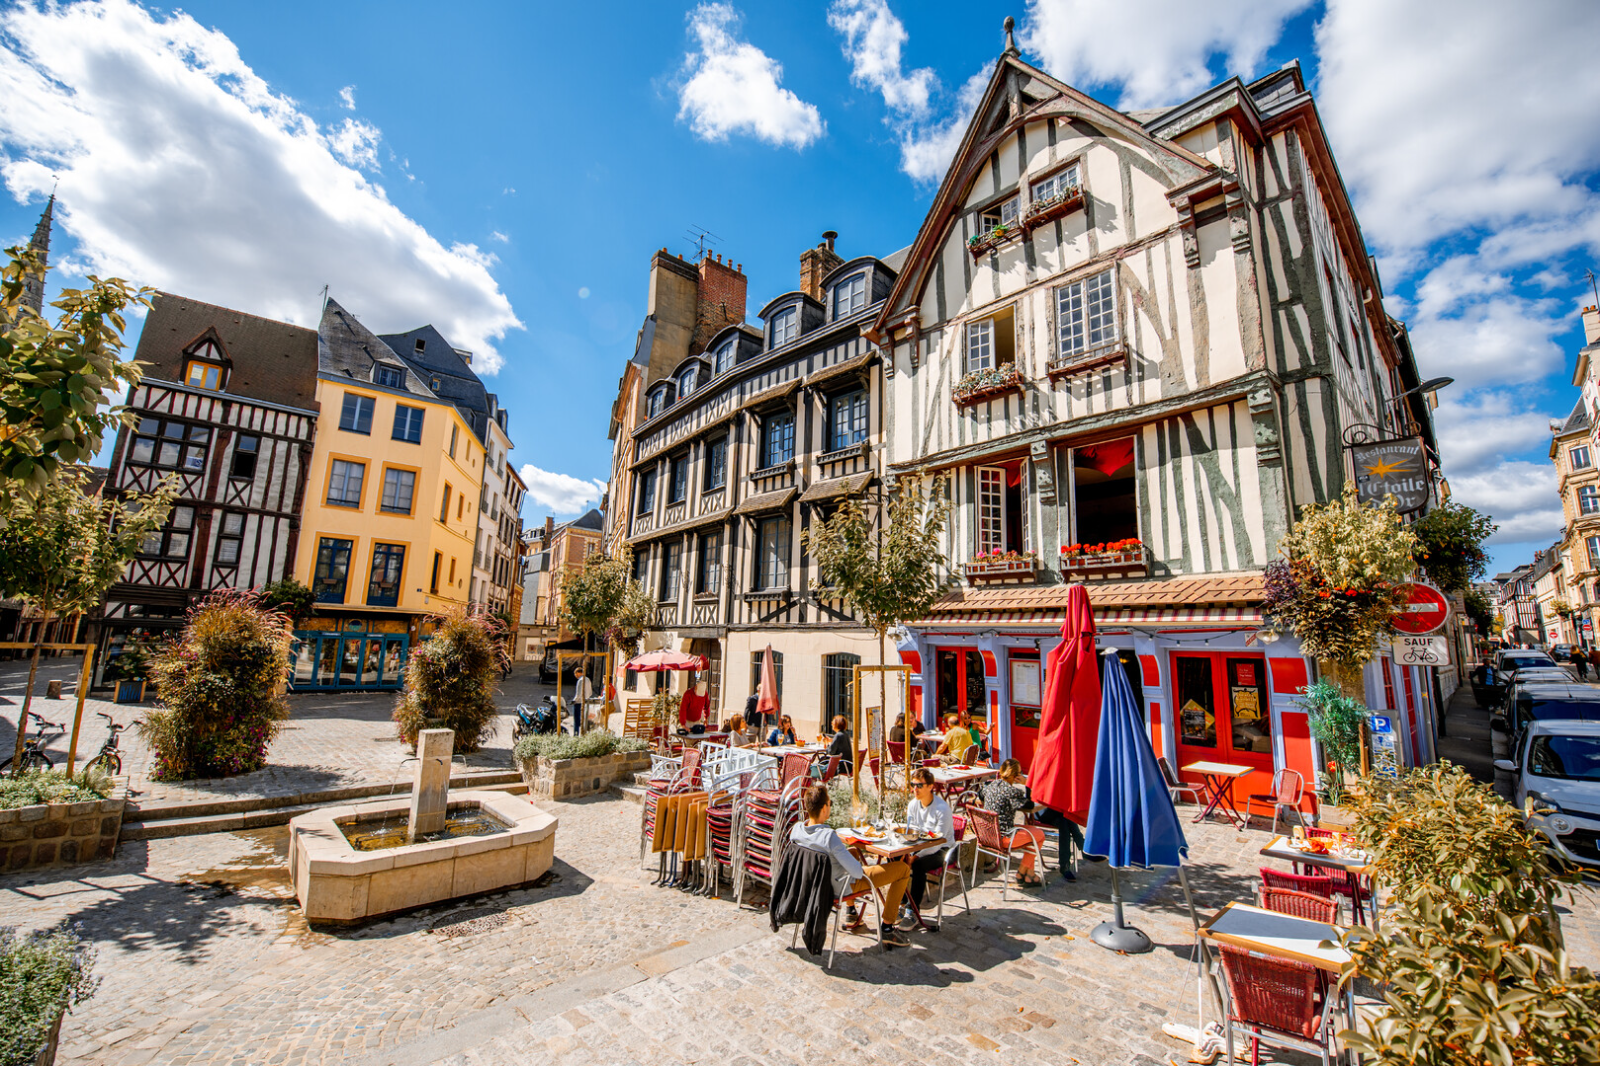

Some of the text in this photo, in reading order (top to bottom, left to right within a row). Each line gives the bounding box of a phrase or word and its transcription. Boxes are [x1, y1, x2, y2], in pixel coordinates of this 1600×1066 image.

[1355, 445, 1420, 461] Restaurant
[1359, 477, 1425, 496] lEtoile
[1404, 638, 1433, 646] SAUF
[1374, 717, 1387, 731] P
